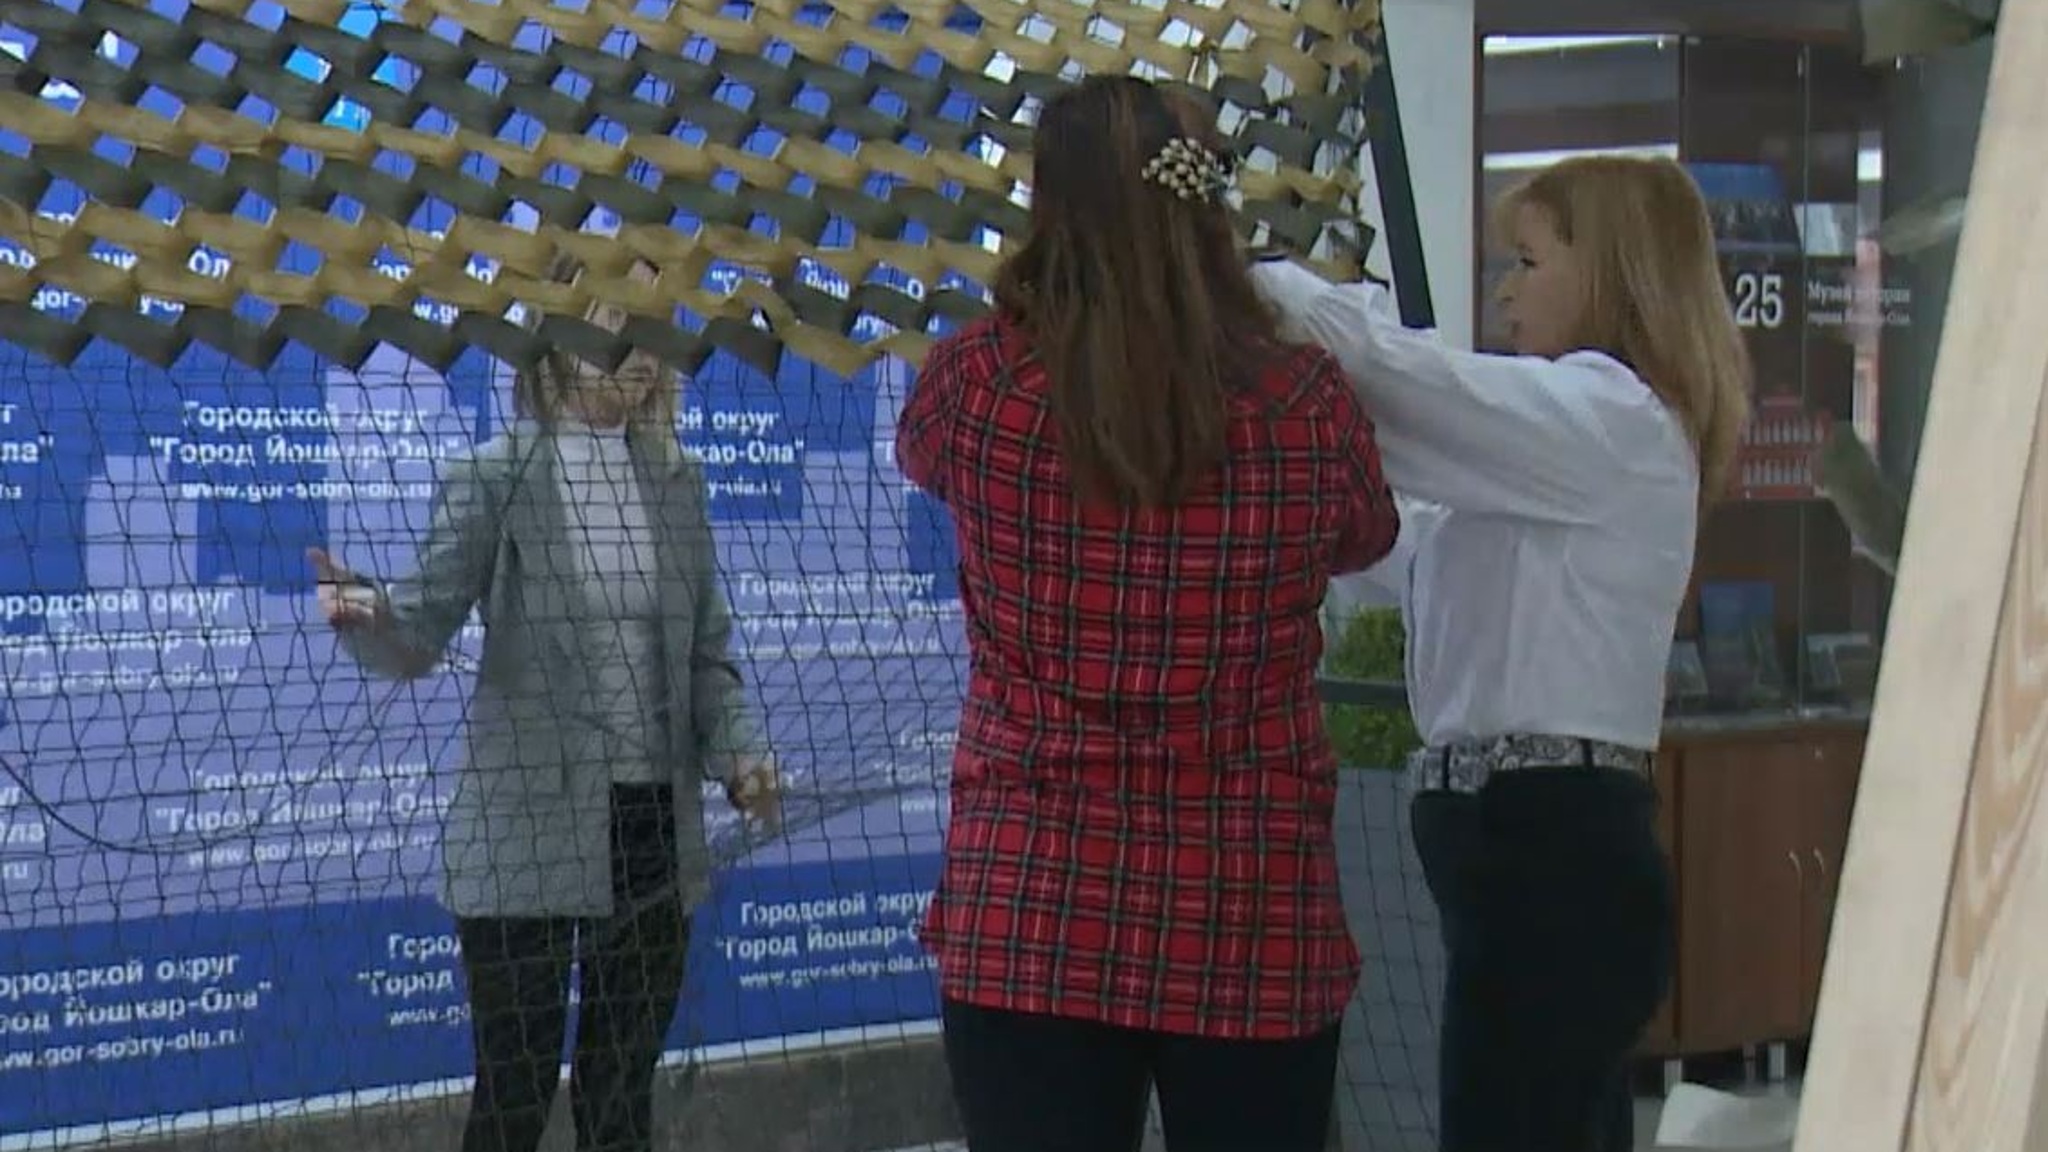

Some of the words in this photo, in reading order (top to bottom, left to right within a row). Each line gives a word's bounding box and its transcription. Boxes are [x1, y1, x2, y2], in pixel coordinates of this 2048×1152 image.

[1735, 272, 1784, 328] 25
[712, 410, 779, 436] округ
[0, 587, 140, 621] родской
[741, 890, 867, 928] Городской
[156, 953, 240, 985] округ
